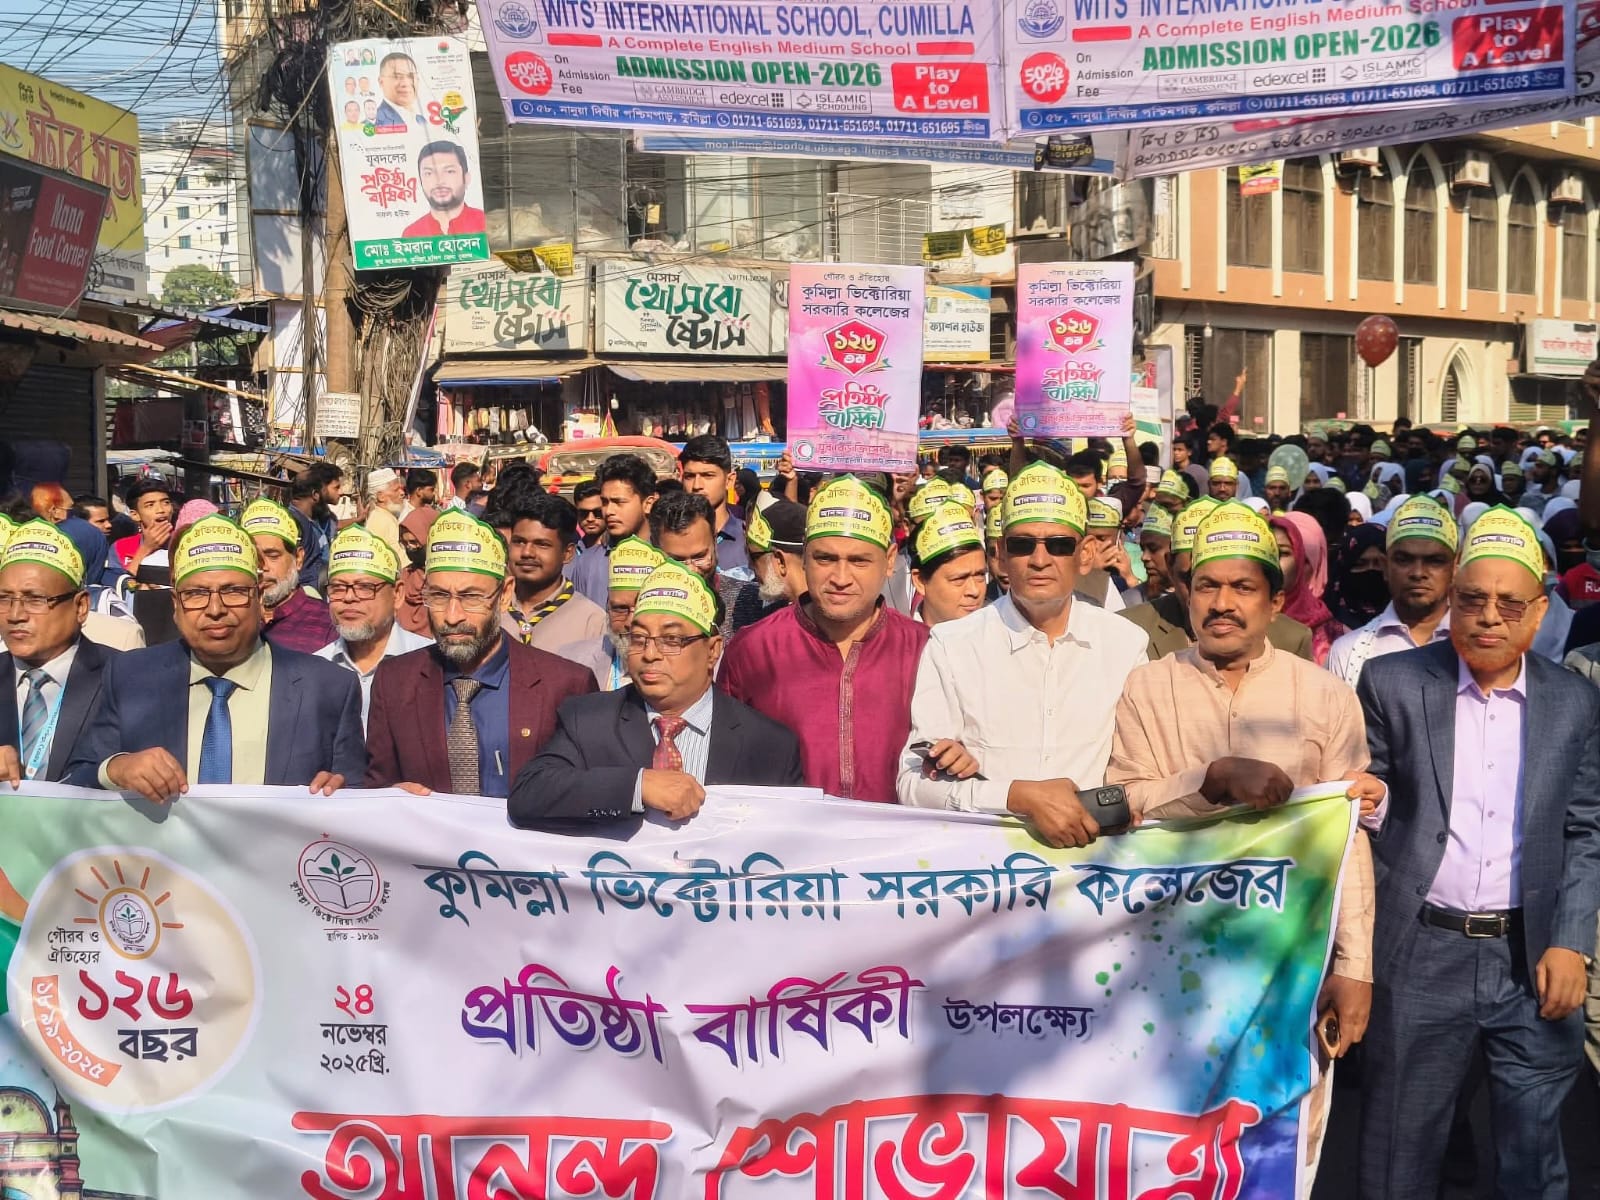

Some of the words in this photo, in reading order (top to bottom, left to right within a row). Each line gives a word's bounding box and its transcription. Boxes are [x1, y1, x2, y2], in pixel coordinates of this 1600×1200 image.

[541, 0, 598, 29] WITS'
[605, 1, 771, 35] INTERNATIONAL
[776, 5, 873, 38] SCHOOL,
[878, 5, 975, 36] CUMILLA
[1138, 24, 1151, 38] A
[1156, 17, 1243, 38] Complete
[1250, 12, 1320, 32] English
[1327, 4, 1402, 22] Medium
[1409, 0, 1477, 13] School
[1479, 16, 1532, 34] Play
[608, 37, 621, 49] A
[624, 37, 704, 53] Complete
[708, 40, 772, 56] English
[777, 41, 845, 55] Medium
[851, 42, 911, 56] School
[1142, 37, 1288, 71] ADMISSION
[1294, 21, 1441, 60] OPEN-2026
[1493, 34, 1518, 47] to
[554, 54, 569, 65] On
[1076, 52, 1092, 63] On
[1462, 53, 1480, 67] A
[1486, 45, 1551, 65] Level
[508, 60, 545, 76] 50%
[616, 55, 747, 83] ADMISSION
[752, 61, 882, 87] OPEN-2026
[1024, 63, 1063, 79] 50%
[1362, 57, 1422, 73] ISLAMIC
[519, 73, 548, 88] OFF
[558, 69, 611, 81] Admission
[915, 66, 960, 82] Play
[1076, 68, 1134, 80] Admission
[1253, 68, 1309, 88] edexcel
[561, 83, 583, 95] Fee
[928, 82, 949, 95] to
[1032, 78, 1065, 95] OFF
[1076, 85, 1100, 97] Fee
[1442, 75, 1529, 95] 01711-651695
[719, 92, 769, 107] edexcel
[815, 93, 867, 104] ISLAMIC
[816, 103, 868, 111] SCHOOLING
[902, 97, 917, 109] A
[924, 96, 978, 110] Level
[732, 114, 806, 131] 01711-651693,
[808, 119, 885, 133] 01711-651694,
[887, 121, 960, 134] 01711-651695
[366, 153, 407, 167] যুবদলের
[360, 167, 406, 192] প্রতিষ্ঠা
[50, 193, 85, 235] Nana
[28, 227, 57, 260] Food
[56, 235, 90, 269] Corner
[364, 243, 390, 257] মোঃ
[391, 240, 433, 256] ইমরান
[438, 237, 481, 252] হোসেন
[477, 267, 509, 281] মেসার্স
[647, 270, 683, 283] মেসার্স
[801, 282, 842, 300] কুমিল্লা
[846, 284, 912, 301] ভিক্টোরিয়া
[1028, 279, 1061, 294] কুমিল্লা
[1067, 278, 1122, 292] ভিক্টোরিয়া
[1028, 294, 1069, 306] সরকারি
[1073, 295, 1121, 306] কলেজের
[801, 301, 849, 316] সরকারি
[854, 305, 911, 318] কলেজের
[929, 321, 959, 332] ফ্যাশন
[1055, 317, 1092, 335] ১২৬
[834, 330, 877, 352] ১২৬
[412, 850, 569, 927] কুমিল্লা
[581, 850, 849, 923] ভিক্টোরিয়া
[860, 851, 1061, 920] সরকারি
[1071, 858, 1295, 916] কলেজের
[47, 928, 84, 945] গৌরব
[89, 931, 99, 943] ও
[326, 930, 348, 942] স্থাপিত
[47, 948, 100, 965] ঐতিহ্যের
[77, 969, 194, 1021] ১২৬
[334, 983, 375, 1019] ২৪
[461, 963, 670, 1066] প্রতিষ্ঠা
[684, 964, 926, 1068] বার্ষিকী
[942, 997, 1095, 1039] উপলক্ষ্যে
[319, 1022, 388, 1046] নভেম্বর
[117, 1027, 199, 1063] বছর
